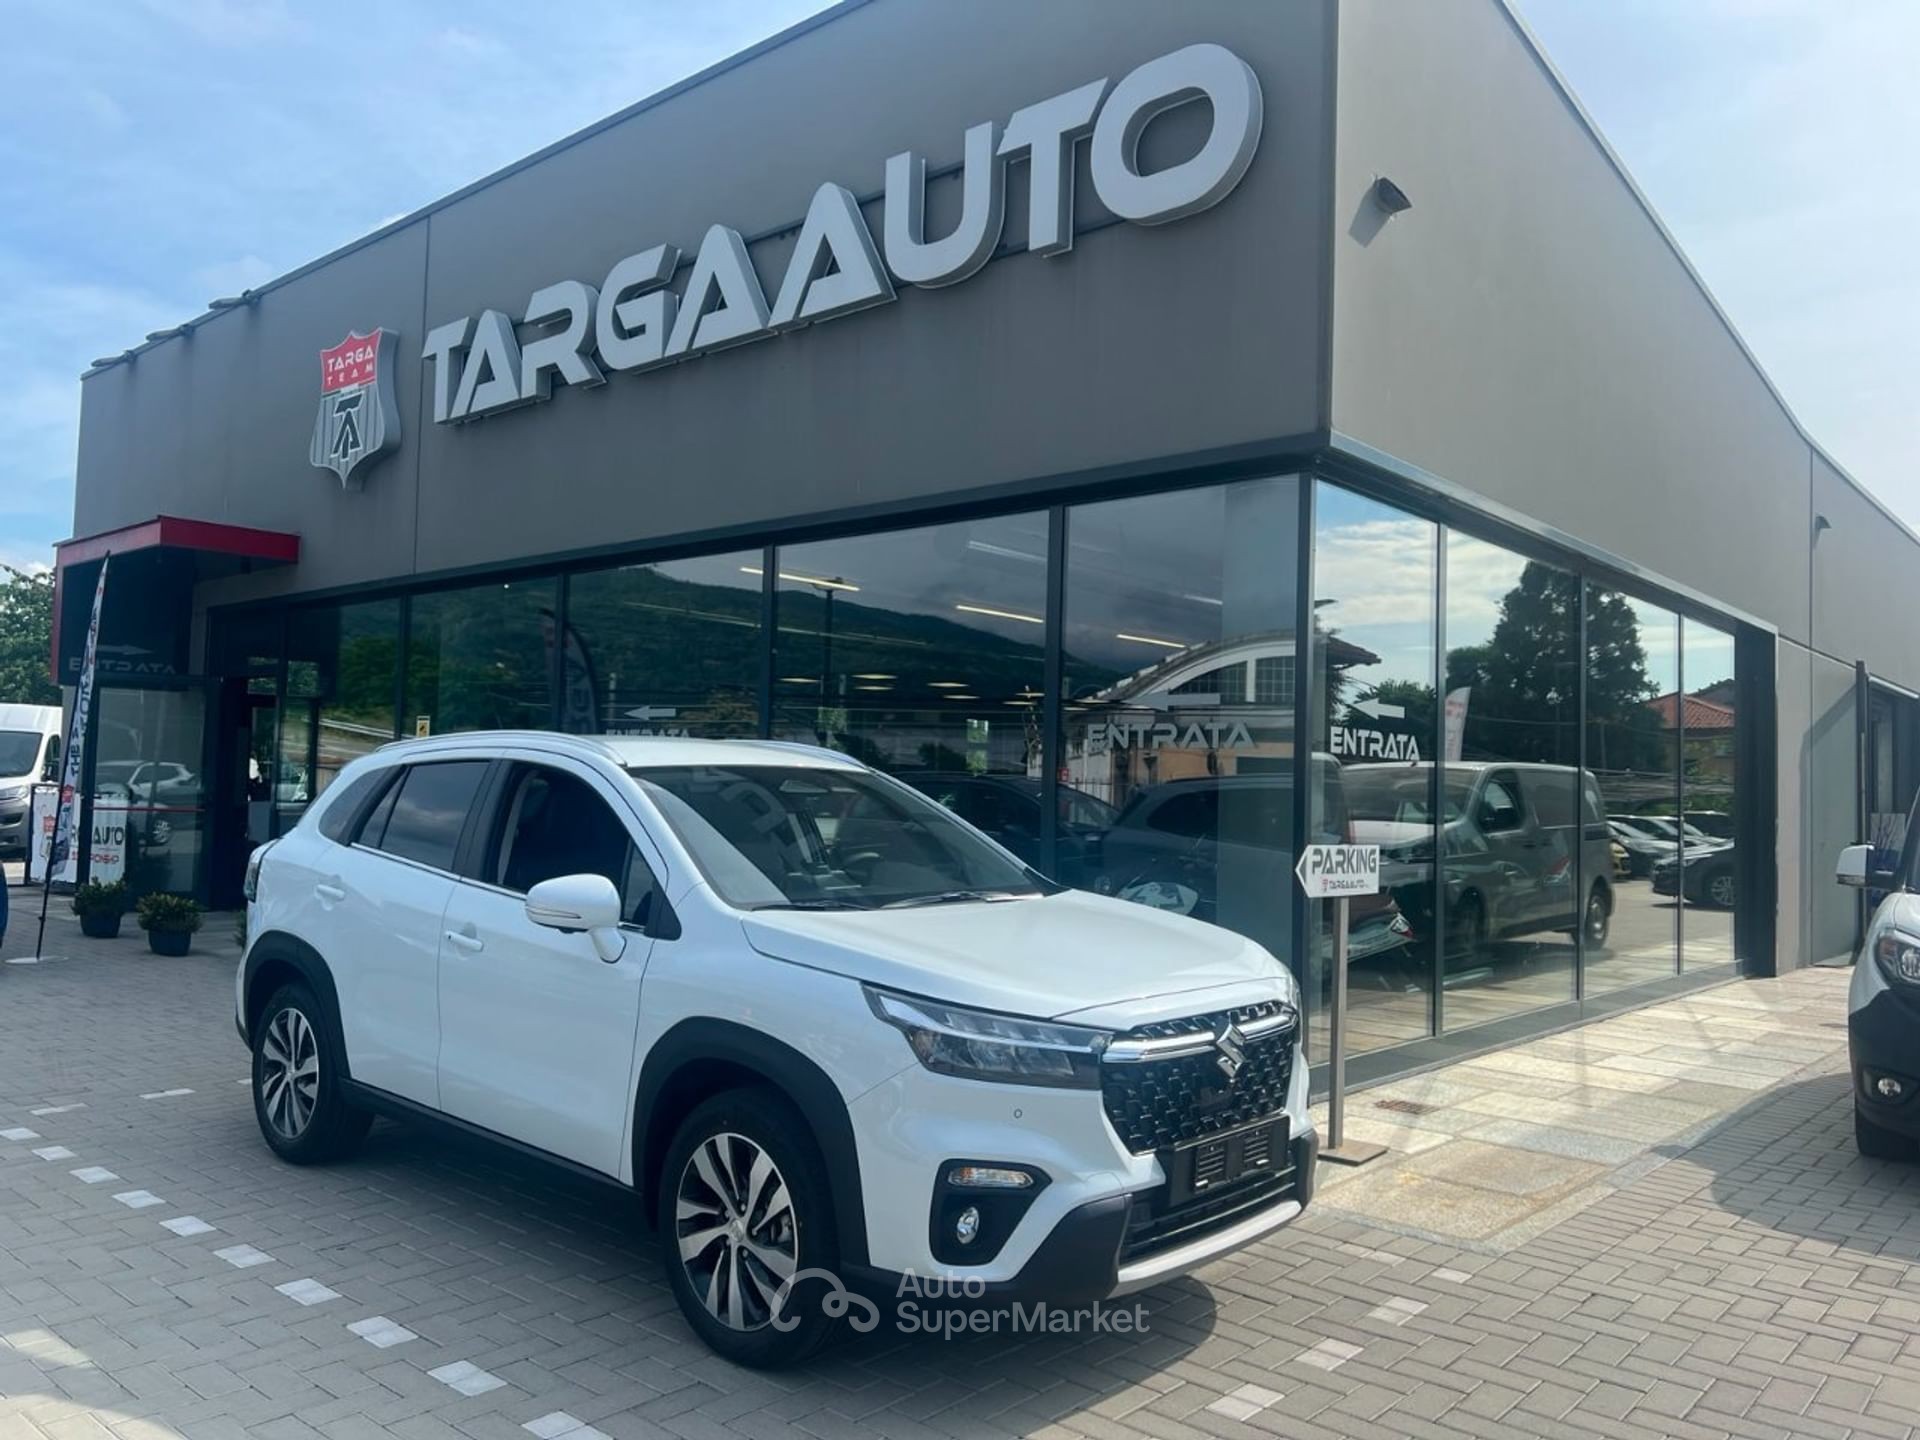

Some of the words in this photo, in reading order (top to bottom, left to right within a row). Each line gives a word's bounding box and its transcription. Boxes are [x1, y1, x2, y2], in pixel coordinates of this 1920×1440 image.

[422, 43, 1264, 425] TARGAAUTO
[327, 345, 375, 373] TARGA
[327, 363, 374, 386] TEAM
[69, 656, 176, 675] ETRATA
[1087, 722, 1256, 750] ENTRATA
[1330, 725, 1421, 761] ENTRATA
[1311, 847, 1377, 875] PARKING
